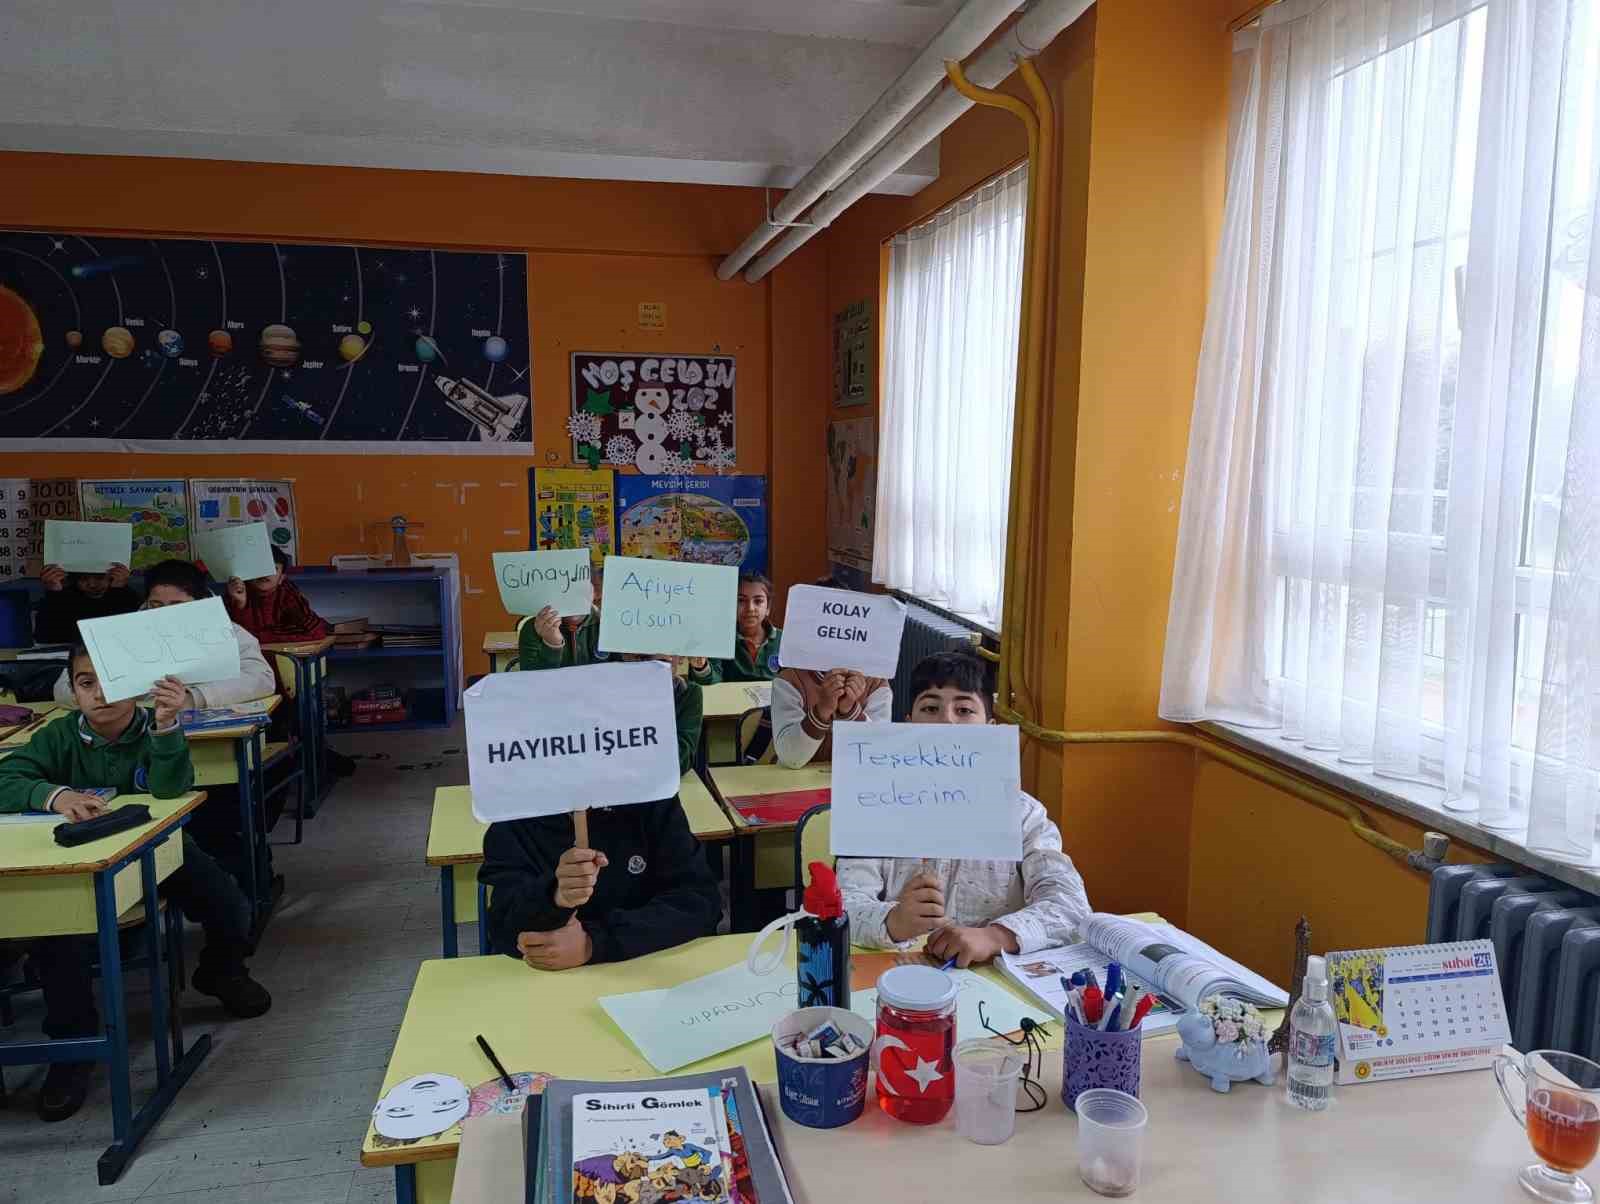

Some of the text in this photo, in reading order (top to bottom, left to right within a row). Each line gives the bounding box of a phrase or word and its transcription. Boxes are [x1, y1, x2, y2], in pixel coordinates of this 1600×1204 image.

[620, 571, 696, 605] Afiyet
[822, 601, 871, 618] KOLAY
[817, 625, 868, 642] GELSİN
[488, 726, 659, 764] HAYIRLI İŞLER
[848, 741, 983, 769] Teşekkür
[585, 1096, 703, 1111] Sihirli Gömlek
